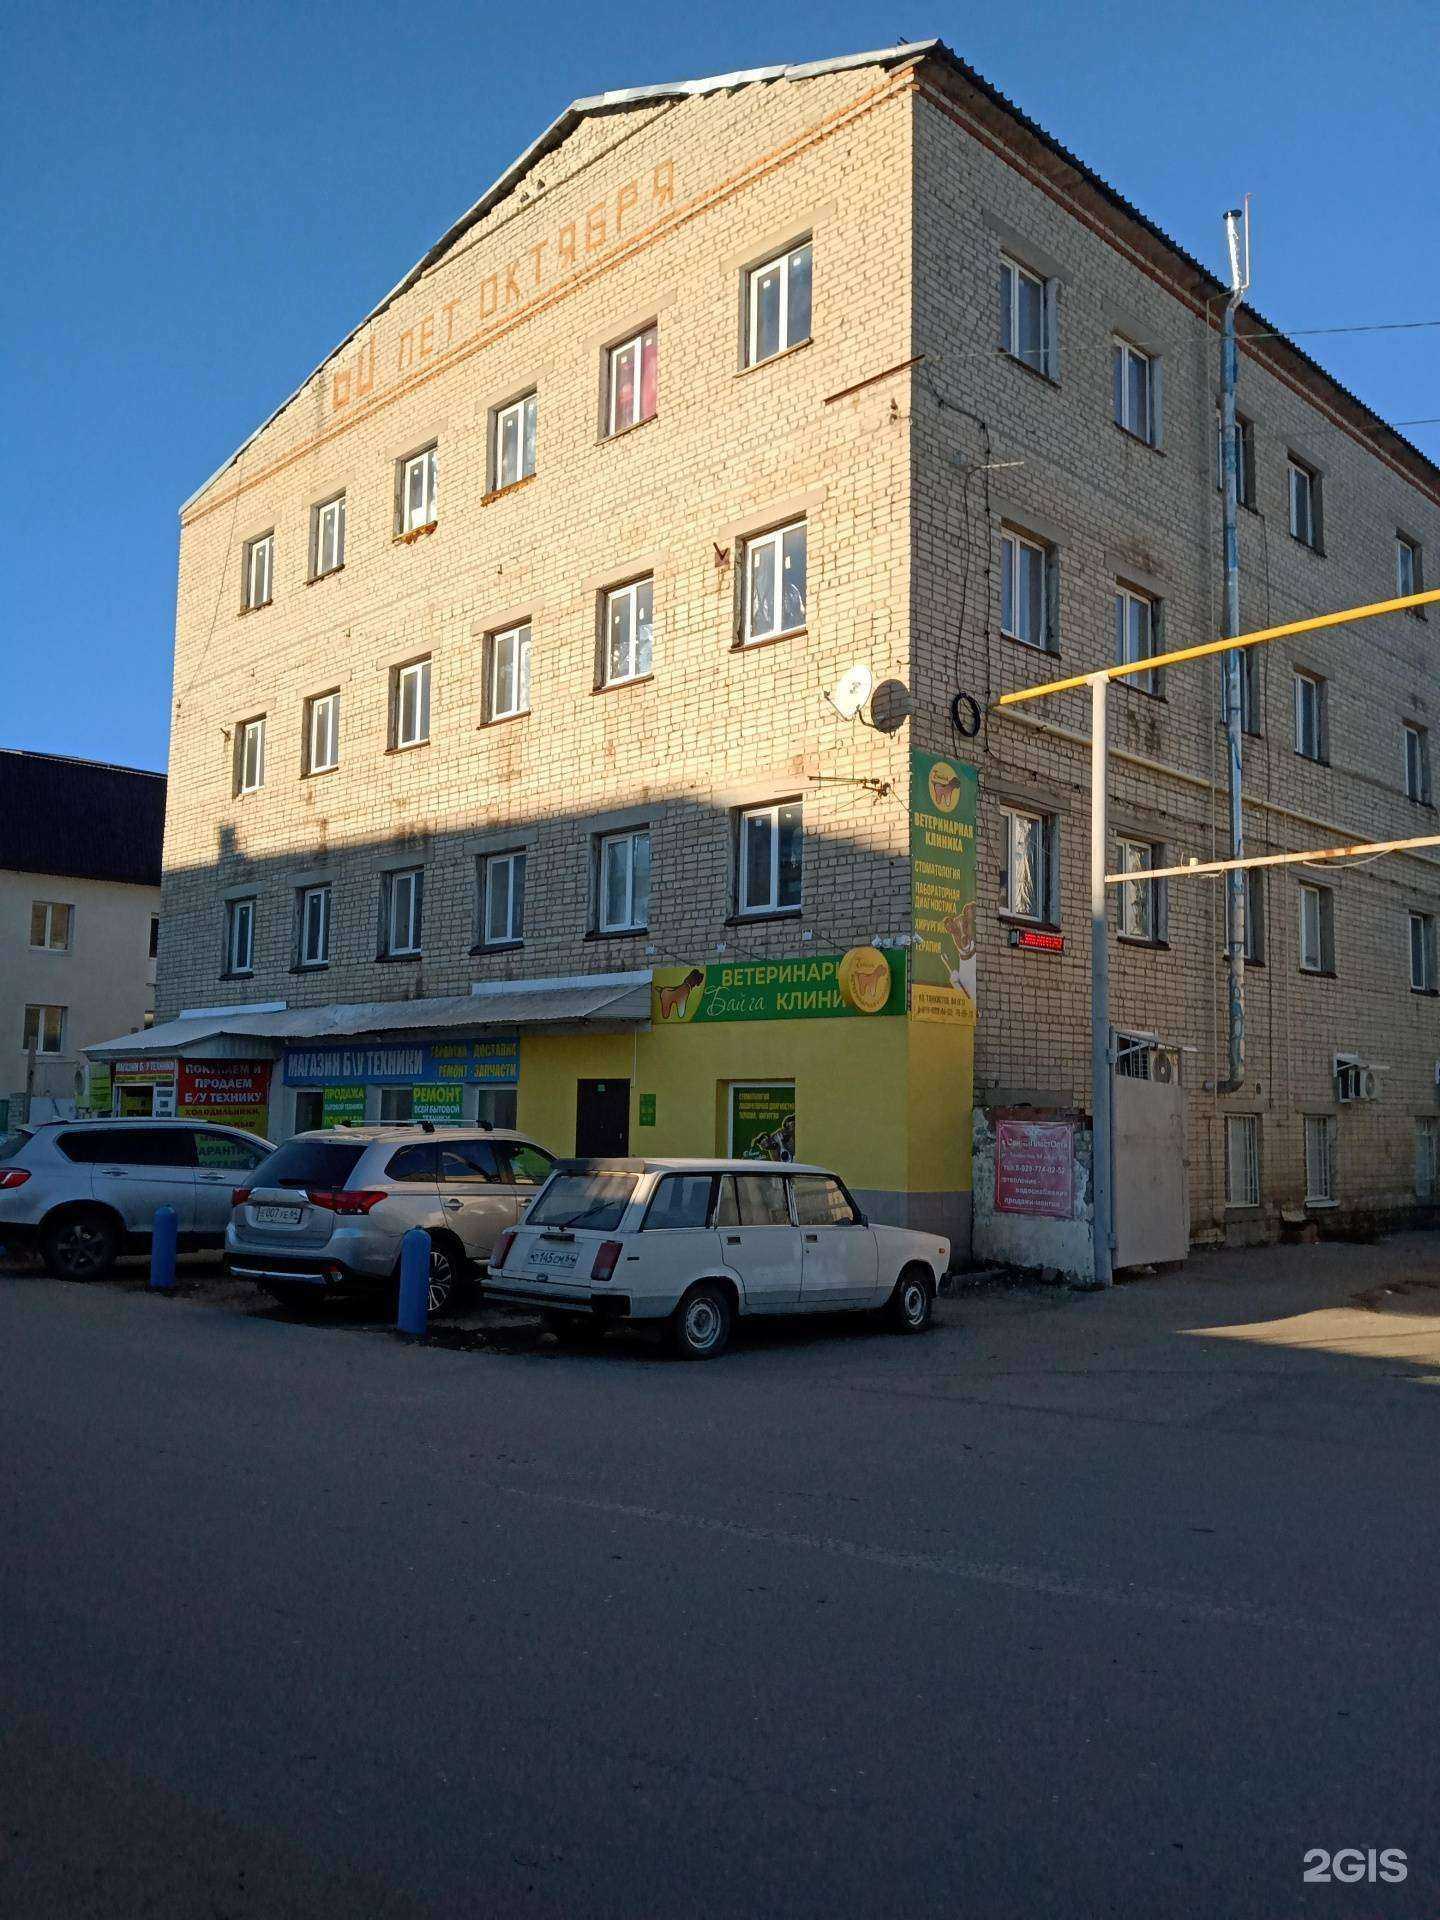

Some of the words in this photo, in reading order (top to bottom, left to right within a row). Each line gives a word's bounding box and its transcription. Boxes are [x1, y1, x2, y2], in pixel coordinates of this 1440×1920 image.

[398, 299, 461, 372] ЛЕТ
[479, 158, 674, 320] ОКТЯБРЯ
[914, 811, 975, 838] ВЕТЕРИНАРНАЯ
[925, 831, 965, 853] КЛИНИКА
[914, 860, 961, 881] СТОМАТОЛОГИЯ
[914, 881, 961, 901] ЛАБОРАТОРНАЯ
[914, 895, 958, 914] ДИАГНОСТИКА
[721, 962, 838, 988] ВЕТЕРИНАР
[776, 991, 846, 1010] КЛИНИ
[185, 1063, 251, 1075] ПОКУПАЕМ
[288, 1052, 340, 1077] МАГАЗИН
[366, 1048, 424, 1076] ТЕХНИКИ
[438, 1064, 468, 1078] РЕМОНТ
[474, 1063, 516, 1078] ЗАПЧАСТИ
[195, 1078, 253, 1090] ПРОДАЕМ
[185, 1092, 208, 1104] Б/У
[210, 1092, 262, 1103] ТЕХНИКУ
[325, 1087, 364, 1101] ПРОДАЖА
[413, 1086, 461, 1102] РЕМОНТ
[430, 1105, 460, 1114] БЫТОВОЙ
